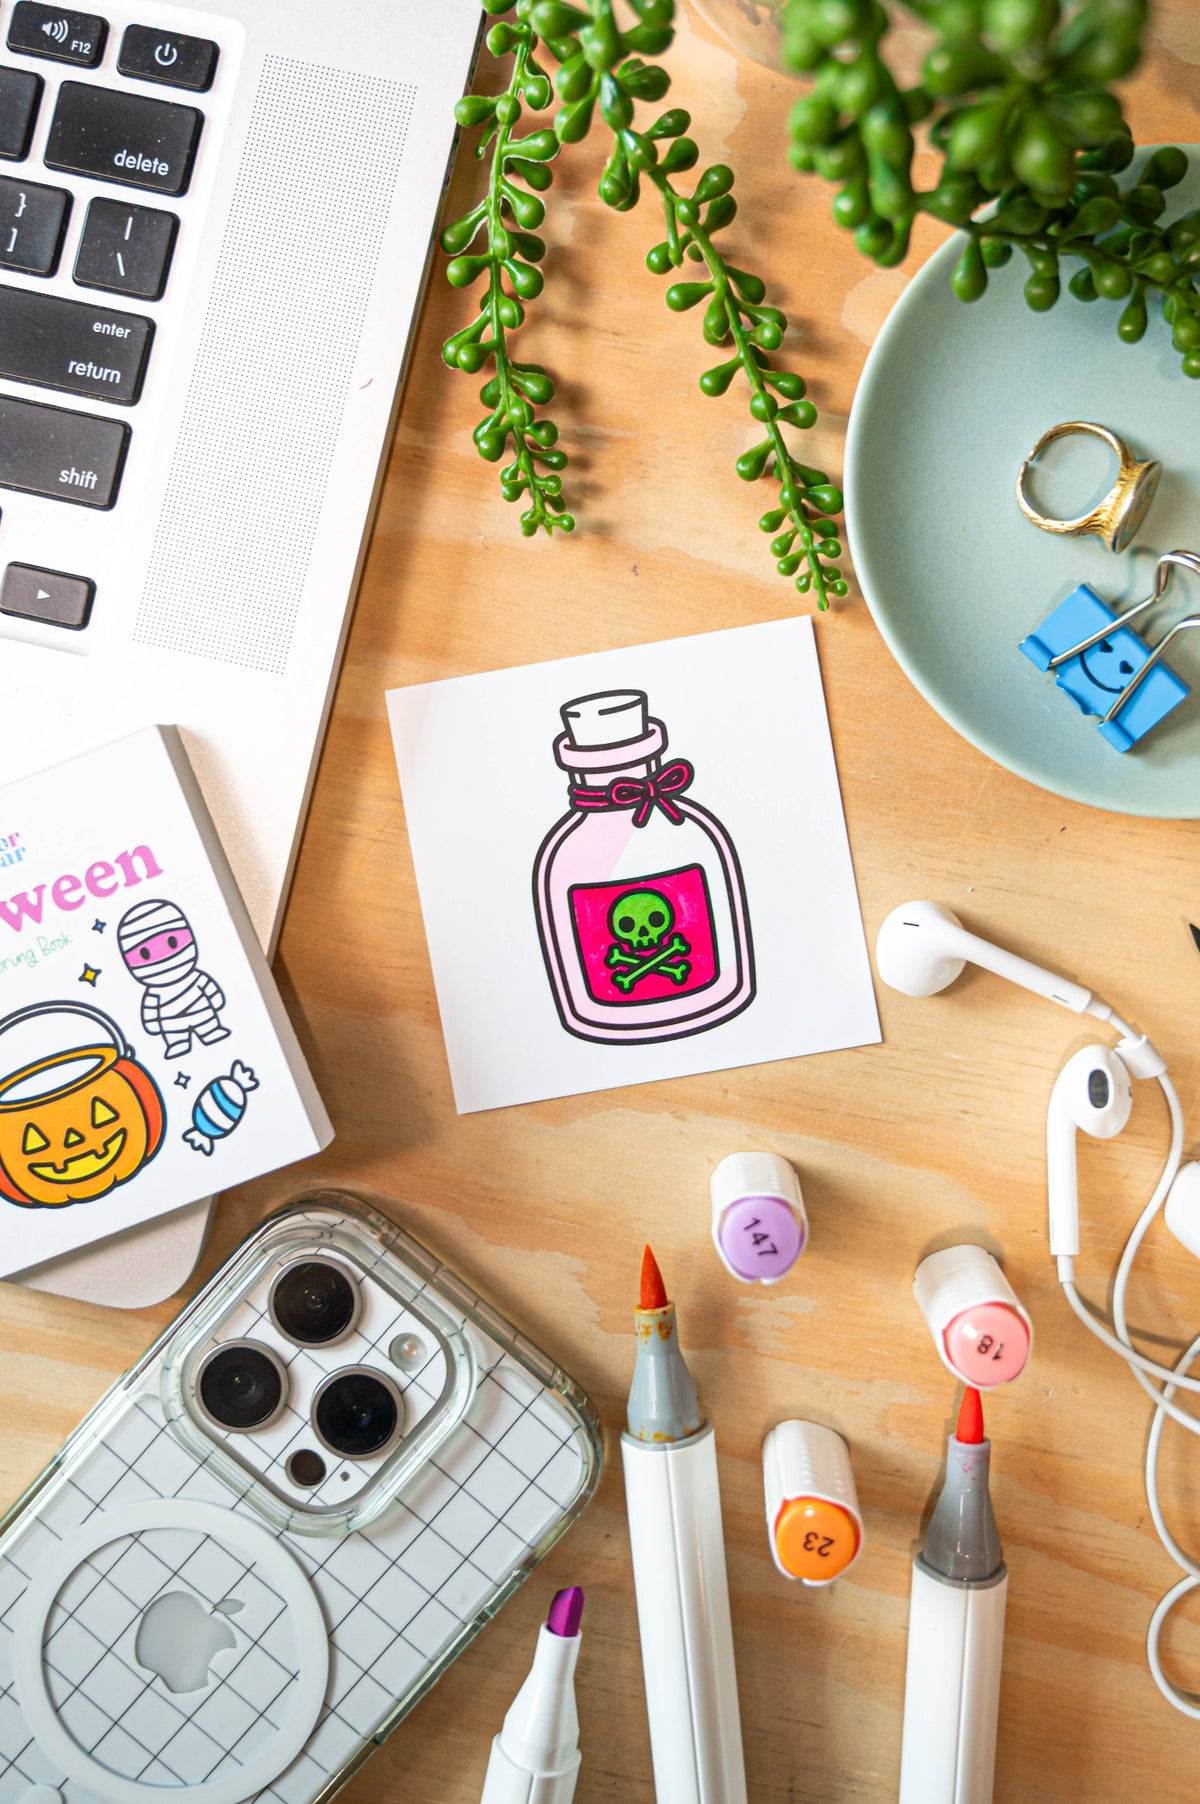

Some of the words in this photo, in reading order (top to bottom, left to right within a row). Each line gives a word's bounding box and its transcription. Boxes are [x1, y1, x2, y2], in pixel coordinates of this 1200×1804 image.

[71, 40, 91, 55] F12
[114, 149, 169, 176] delete
[15, 193, 26, 217] }
[7, 227, 18, 252] ]
[93, 321, 131, 339] enter
[68, 359, 121, 384] return
[58, 467, 98, 490] shift
[0, 845, 164, 933] ween
[36, 931, 72, 956] Book
[743, 1217, 778, 1258] 147
[976, 1334, 1005, 1361] 18
[802, 1531, 835, 1558] 23
